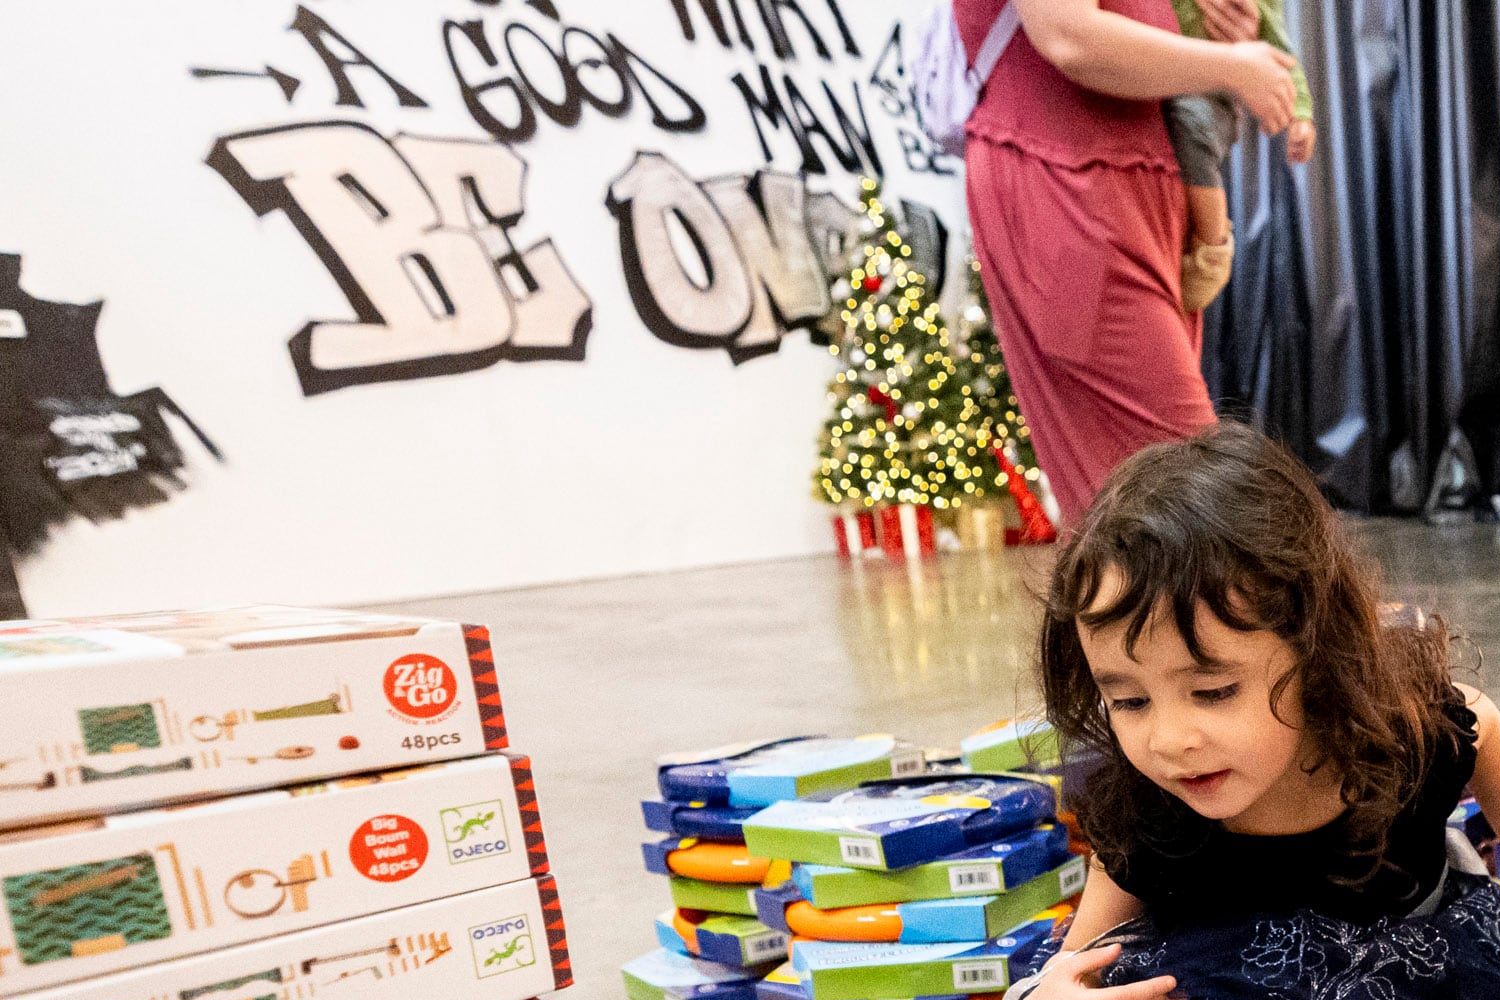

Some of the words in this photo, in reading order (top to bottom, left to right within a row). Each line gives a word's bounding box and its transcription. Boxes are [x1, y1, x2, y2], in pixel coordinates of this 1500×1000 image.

[290, 4, 430, 108] A
[443, 19, 706, 144] GOOD
[731, 64, 883, 178] MAN
[205, 119, 593, 397] BE
[393, 661, 443, 689] Zig
[407, 685, 447, 707] Go
[401, 732, 462, 751] 48pcs
[370, 817, 398, 832] Big
[365, 830, 410, 847] Boum
[373, 843, 408, 860] Wall
[452, 839, 507, 860] DJECO
[368, 858, 420, 877] 48pcs
[472, 918, 526, 941] DJECO
